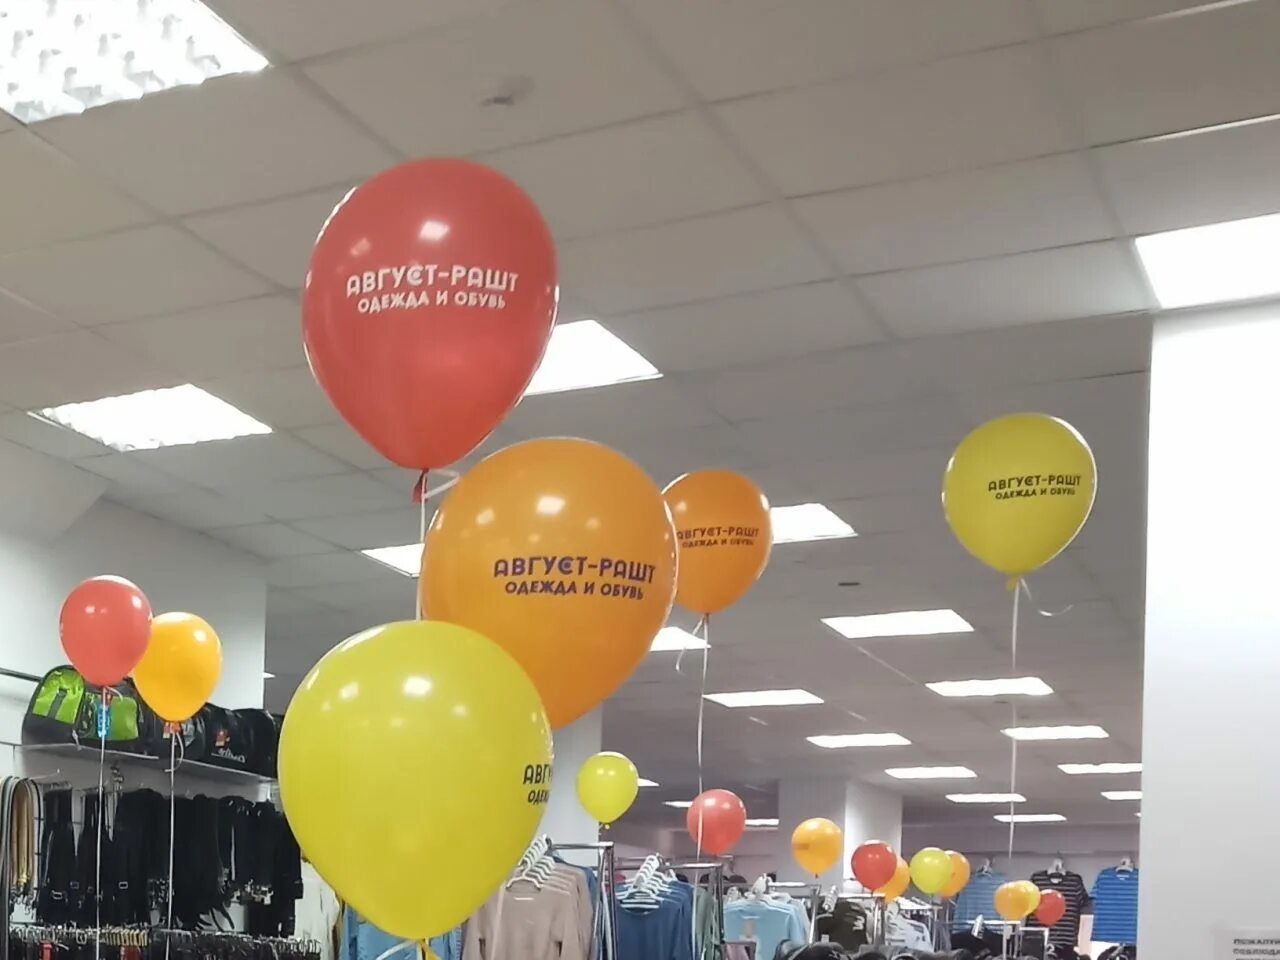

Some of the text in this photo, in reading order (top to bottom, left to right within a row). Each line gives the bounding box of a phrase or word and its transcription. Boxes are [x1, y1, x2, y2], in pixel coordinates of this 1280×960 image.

[347, 264, 518, 297] АВГУСТ-РАШТ
[358, 290, 506, 314] ОДЕЖДА И ОБУВЬ
[988, 475, 1082, 491] АВГУСТ-РАШТ
[995, 488, 1075, 500] ОДЕЖДА И ОБУВЬ
[682, 539, 718, 548] ОДЕЖДА
[494, 556, 656, 583] АВГУСТ-РАШТ
[505, 580, 643, 600] ОДЕЖДА И ОБУВЬ
